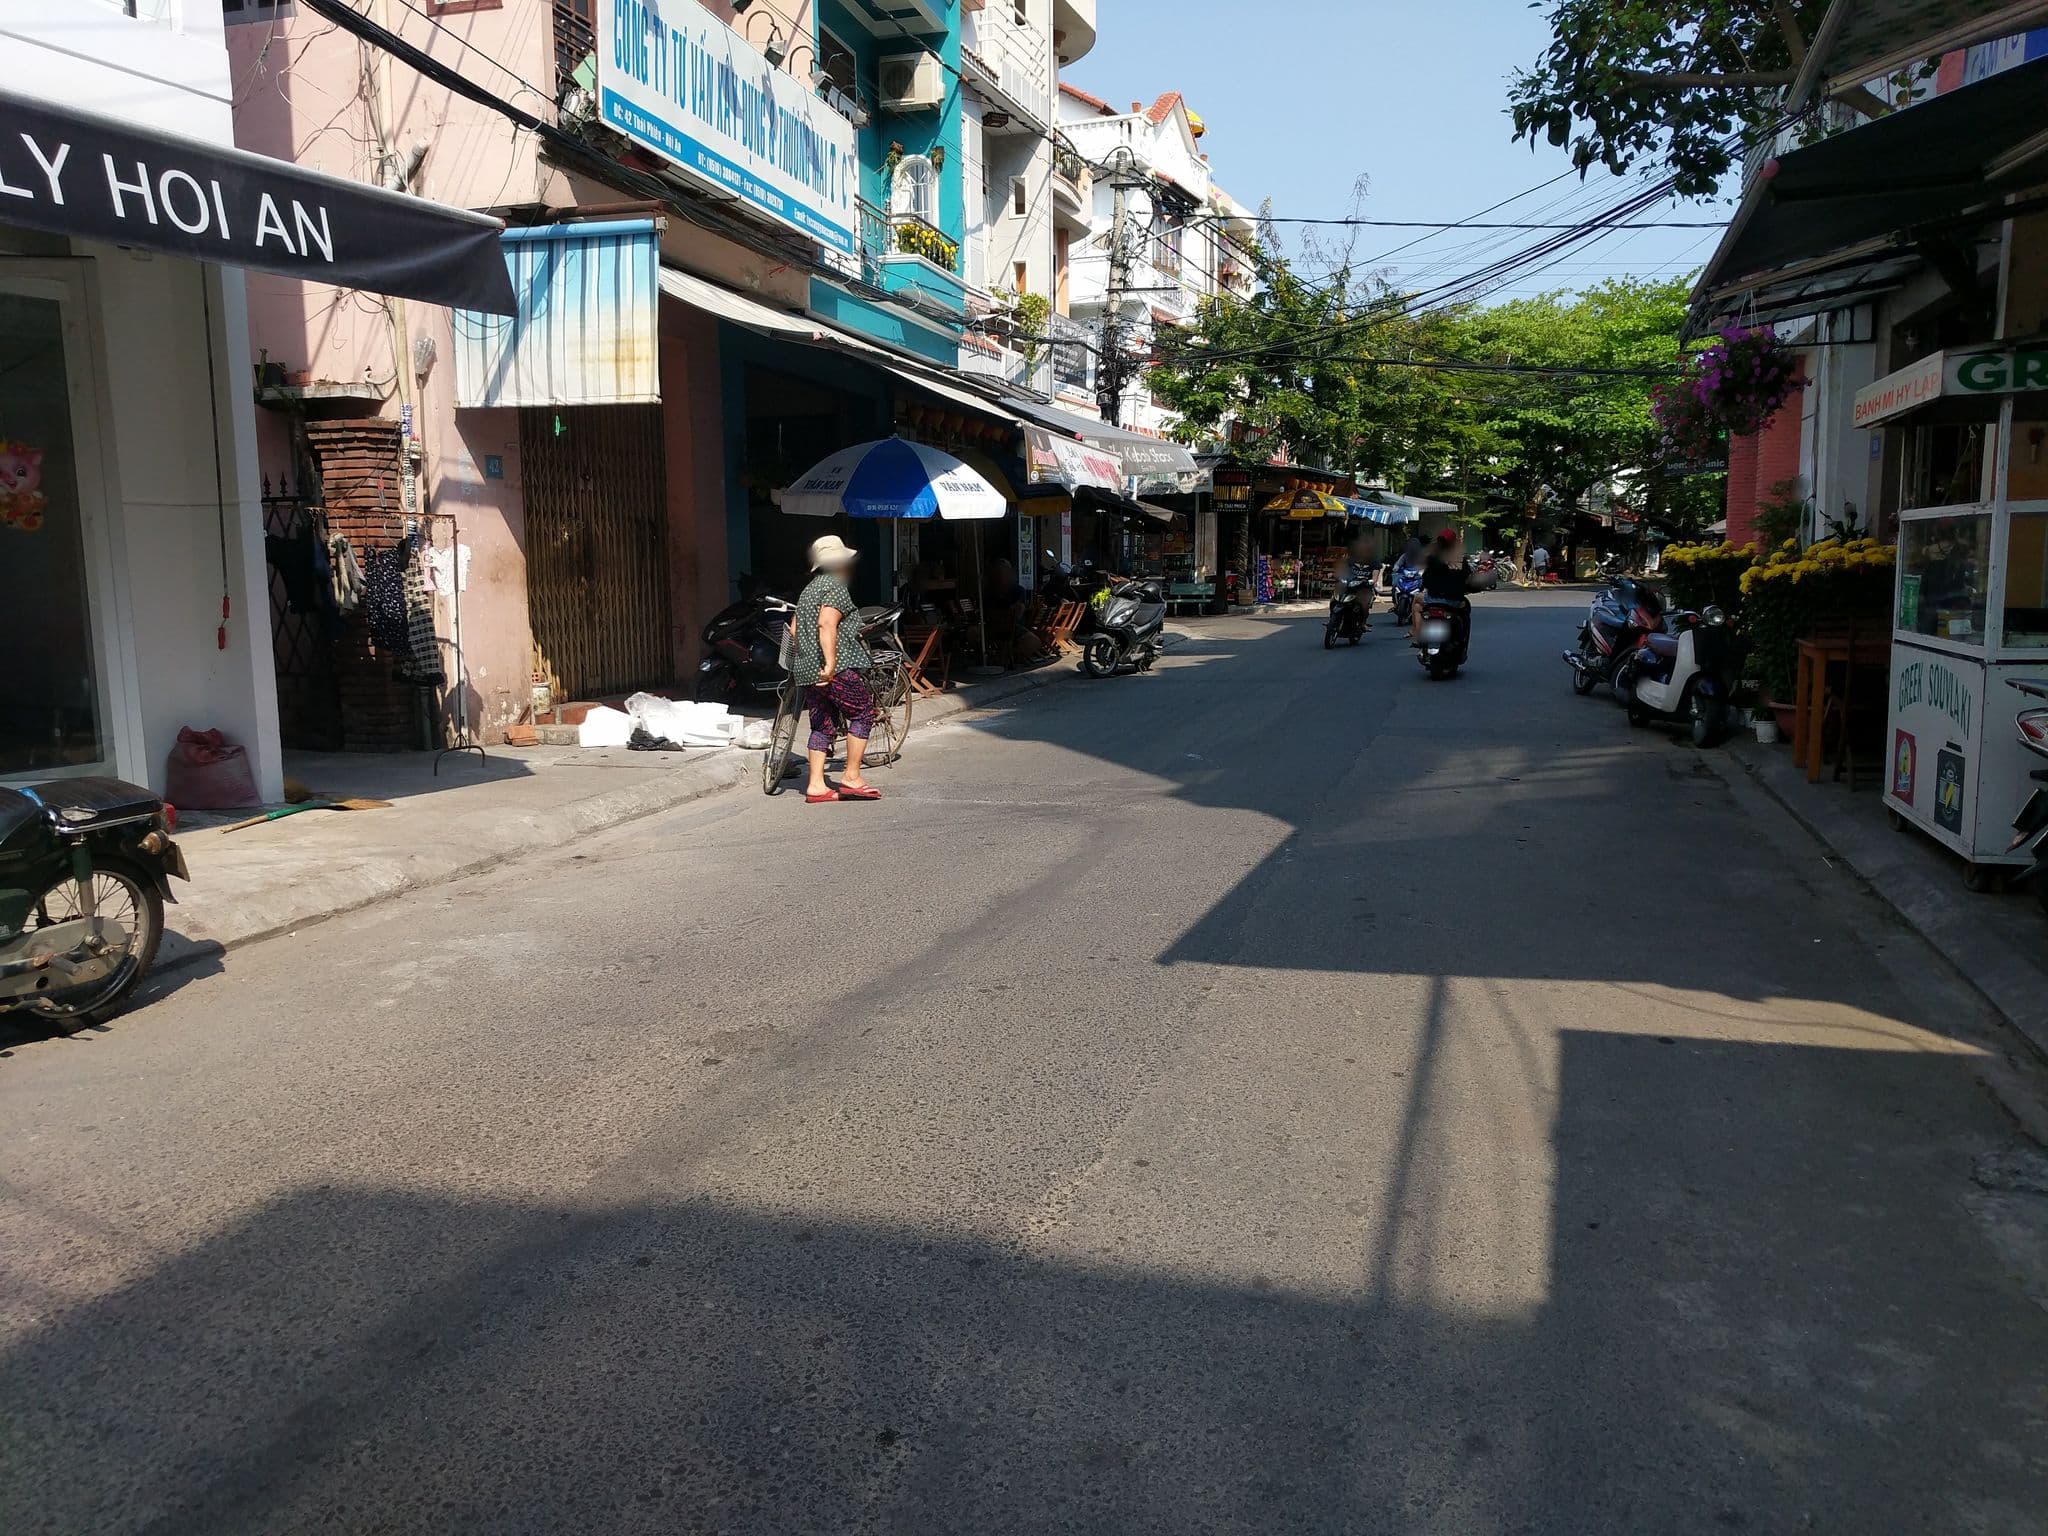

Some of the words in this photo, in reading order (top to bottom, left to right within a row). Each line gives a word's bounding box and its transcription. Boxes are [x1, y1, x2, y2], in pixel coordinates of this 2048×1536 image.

[653, 14, 667, 97] TY
[103, 152, 230, 240] HOI
[256, 192, 334, 263] AN
[1896, 383, 1912, 406] HY
[489, 459, 500, 473] 42
[1230, 485, 1250, 501] MART
[1899, 662, 1923, 713] GREEK
[1927, 663, 1971, 741] SOUVLAKI
